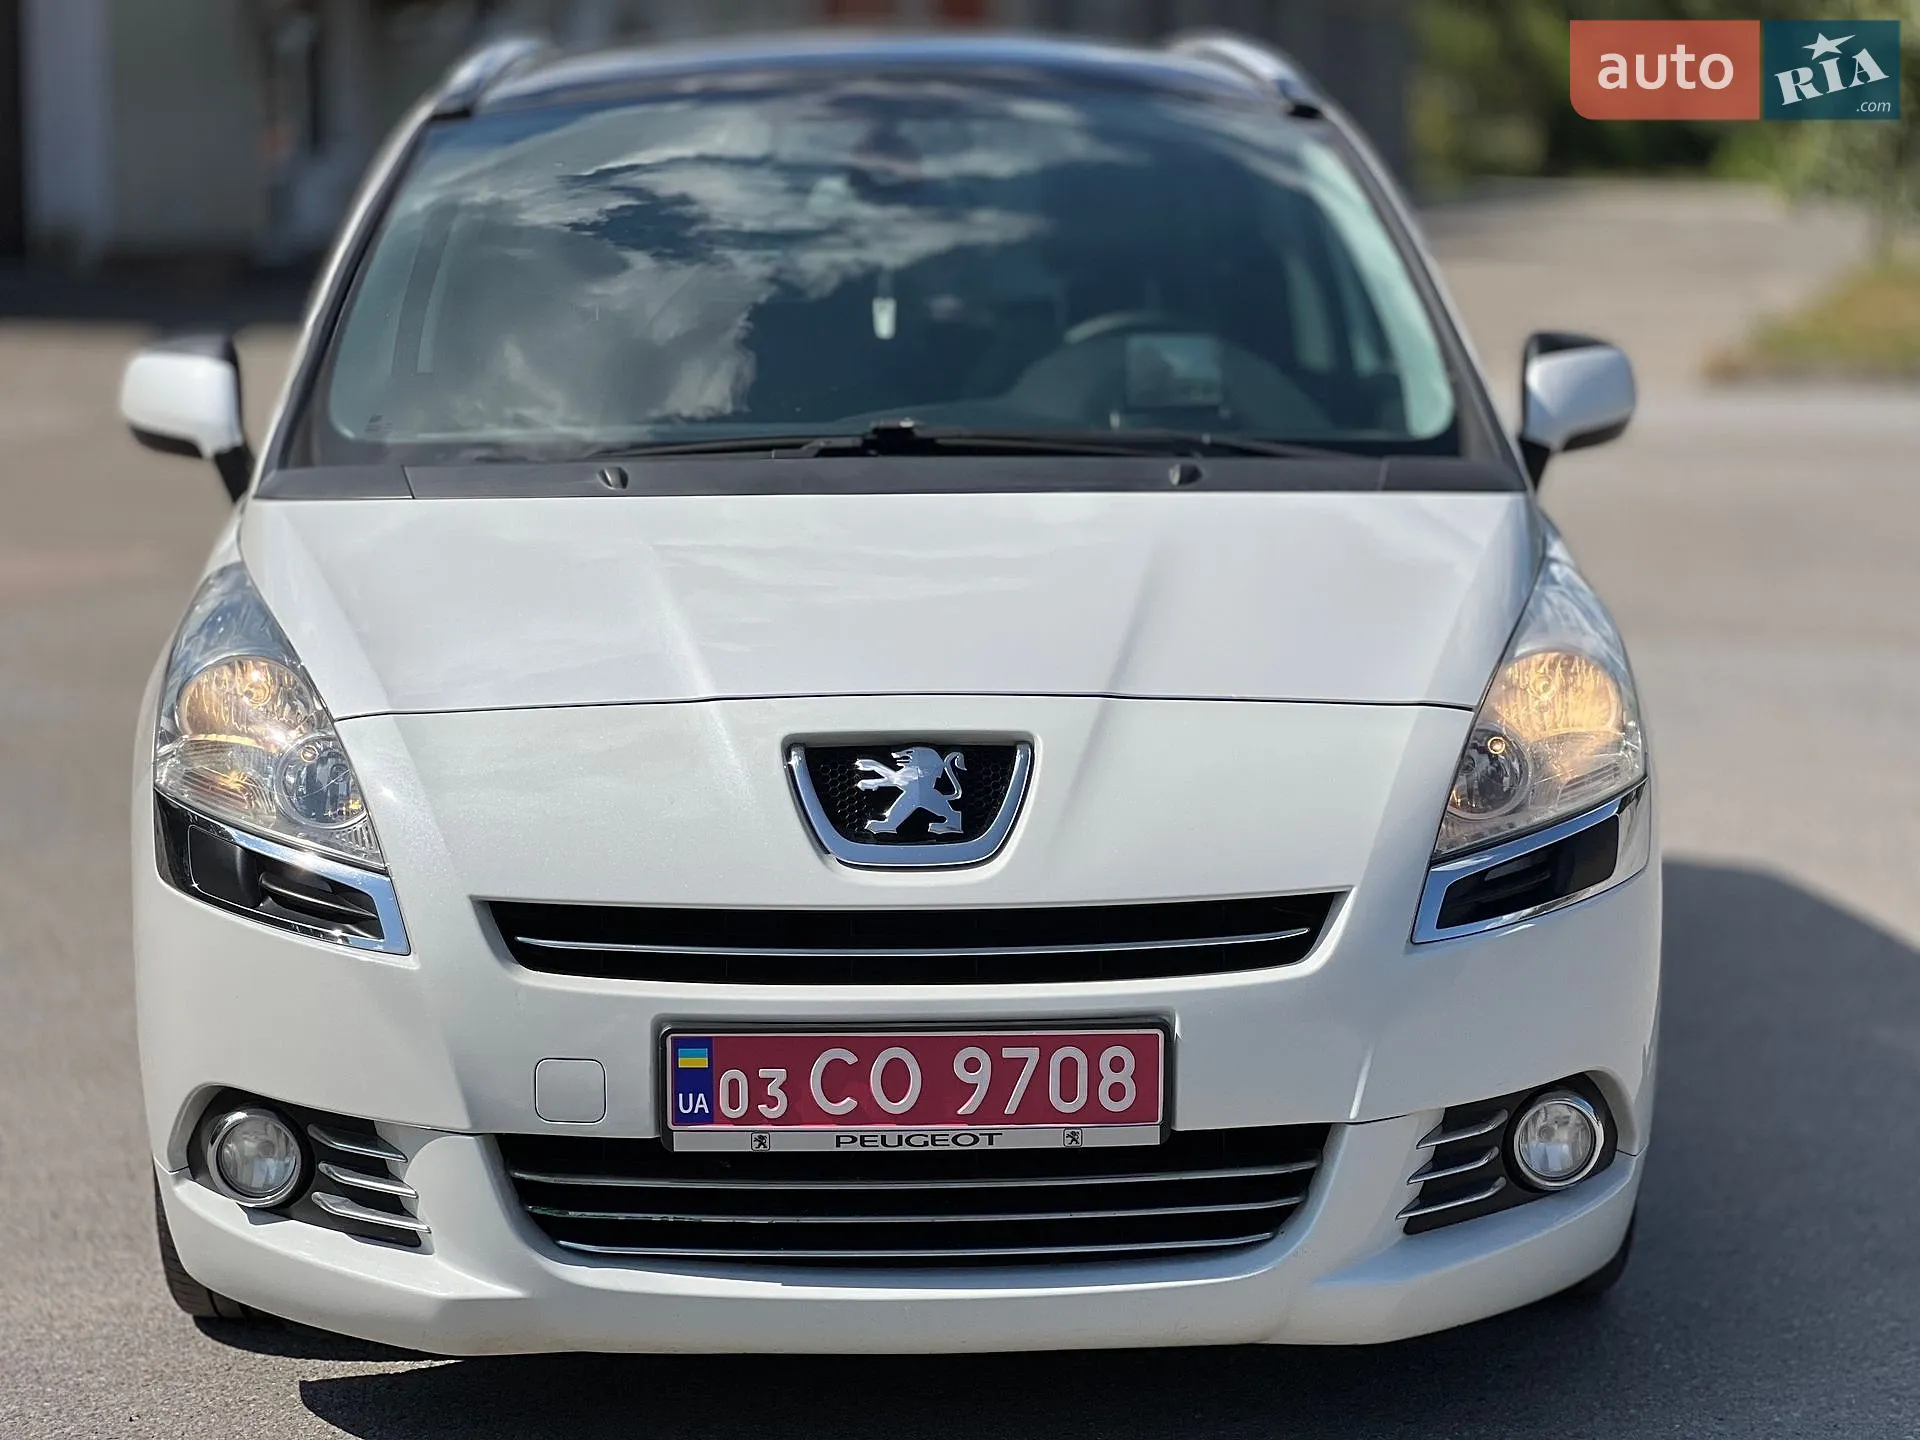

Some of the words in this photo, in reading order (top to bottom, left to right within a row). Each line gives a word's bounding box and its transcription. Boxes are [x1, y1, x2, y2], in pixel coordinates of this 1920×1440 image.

[719, 1069, 788, 1119] 03
[810, 1047, 922, 1115] CO
[953, 1046, 1137, 1115] 9708
[678, 1093, 710, 1114] UA
[835, 1132, 1002, 1148] PEUGEOT
